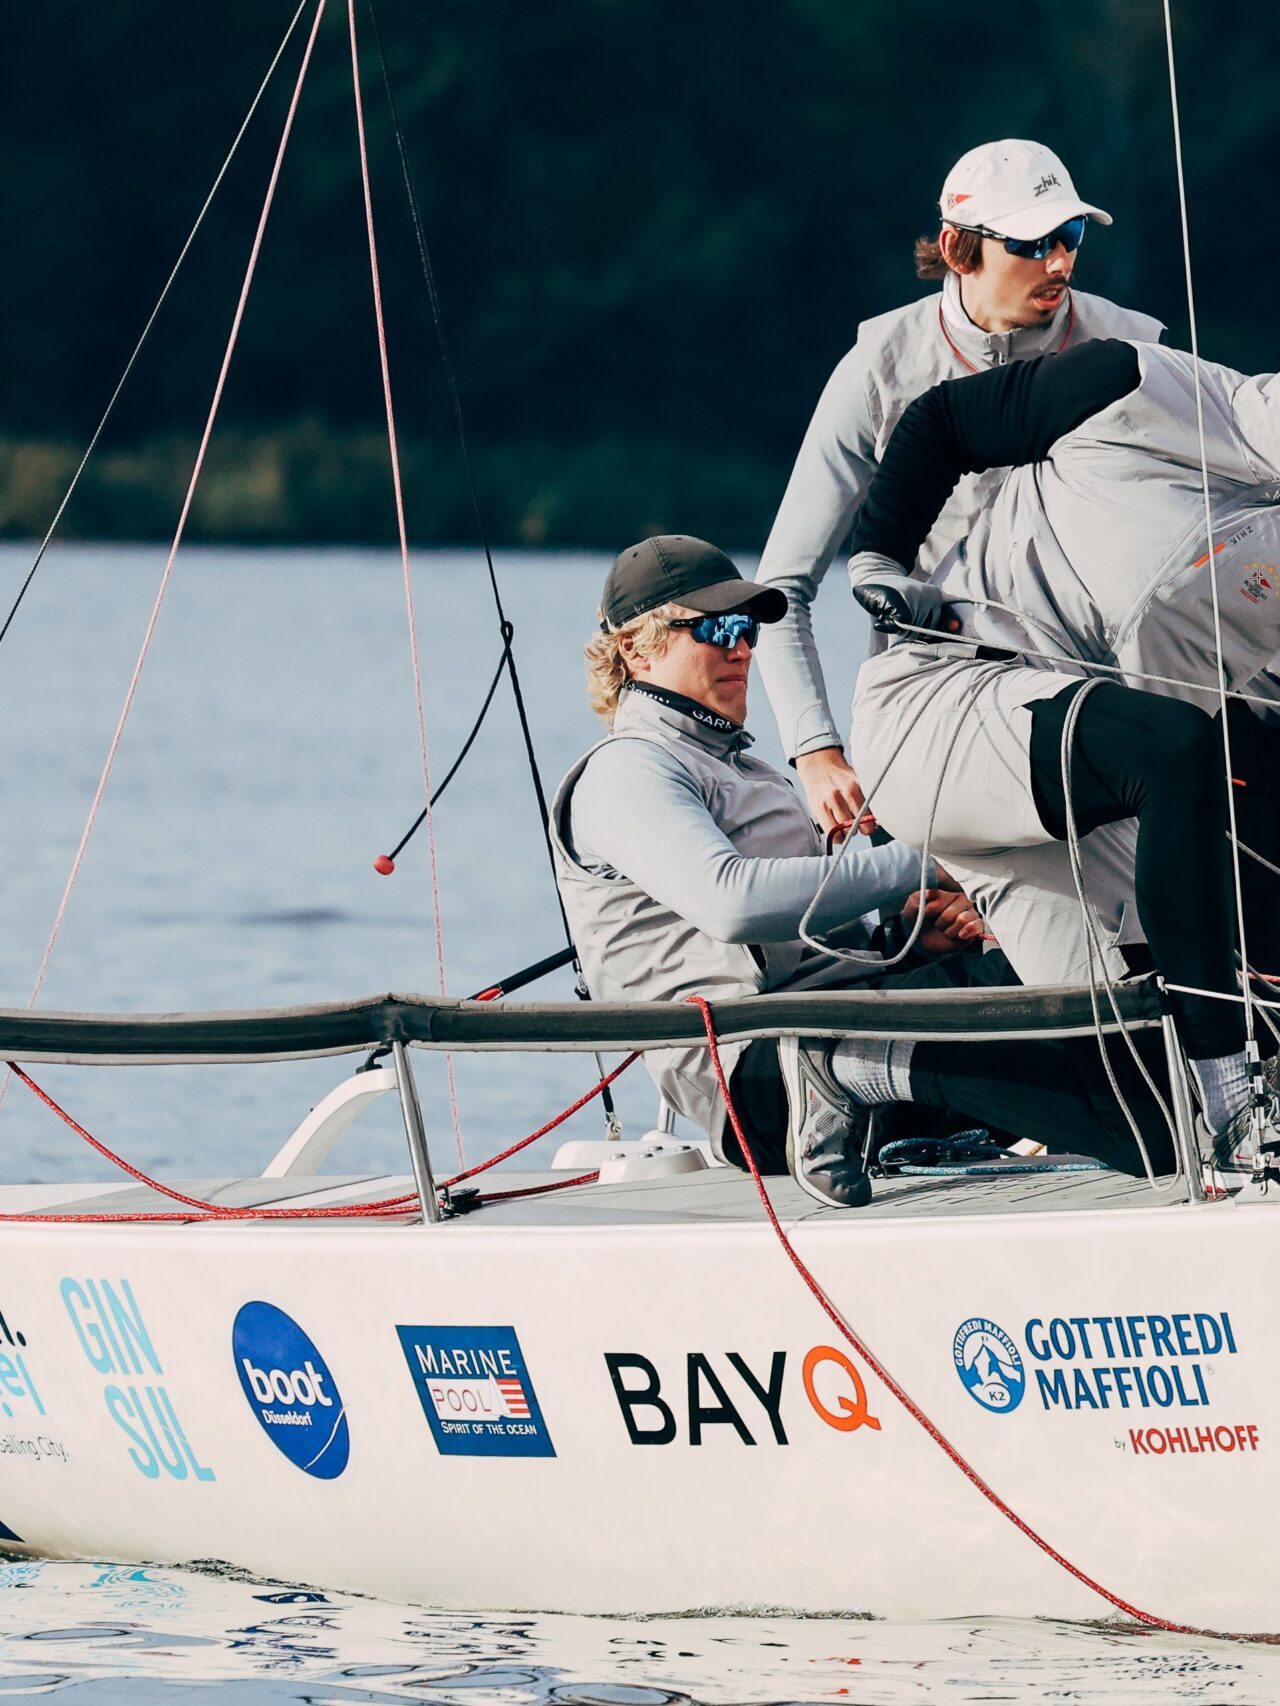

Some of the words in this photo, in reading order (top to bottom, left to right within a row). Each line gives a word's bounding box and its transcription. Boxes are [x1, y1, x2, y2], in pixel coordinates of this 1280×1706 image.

[60, 1277, 164, 1375] GIN
[1025, 1312, 1238, 1361] GOTTIFREDI
[955, 1319, 982, 1367] GOTTIFREDI
[984, 1321, 1021, 1366] MAFFIOLI
[414, 1344, 518, 1376] MARINE
[242, 1358, 333, 1407] boot
[988, 1391, 1006, 1401] K2
[432, 1388, 492, 1412] POOL
[104, 1384, 217, 1482] SUL
[262, 1409, 312, 1426] Düsseldorf
[441, 1421, 470, 1434] SPIRIT
[472, 1423, 484, 1434] OF
[485, 1423, 506, 1435] THE
[506, 1424, 538, 1436] OCEAN
[1113, 1435, 1126, 1451] by
[1128, 1424, 1260, 1455] KOHLHOFF
